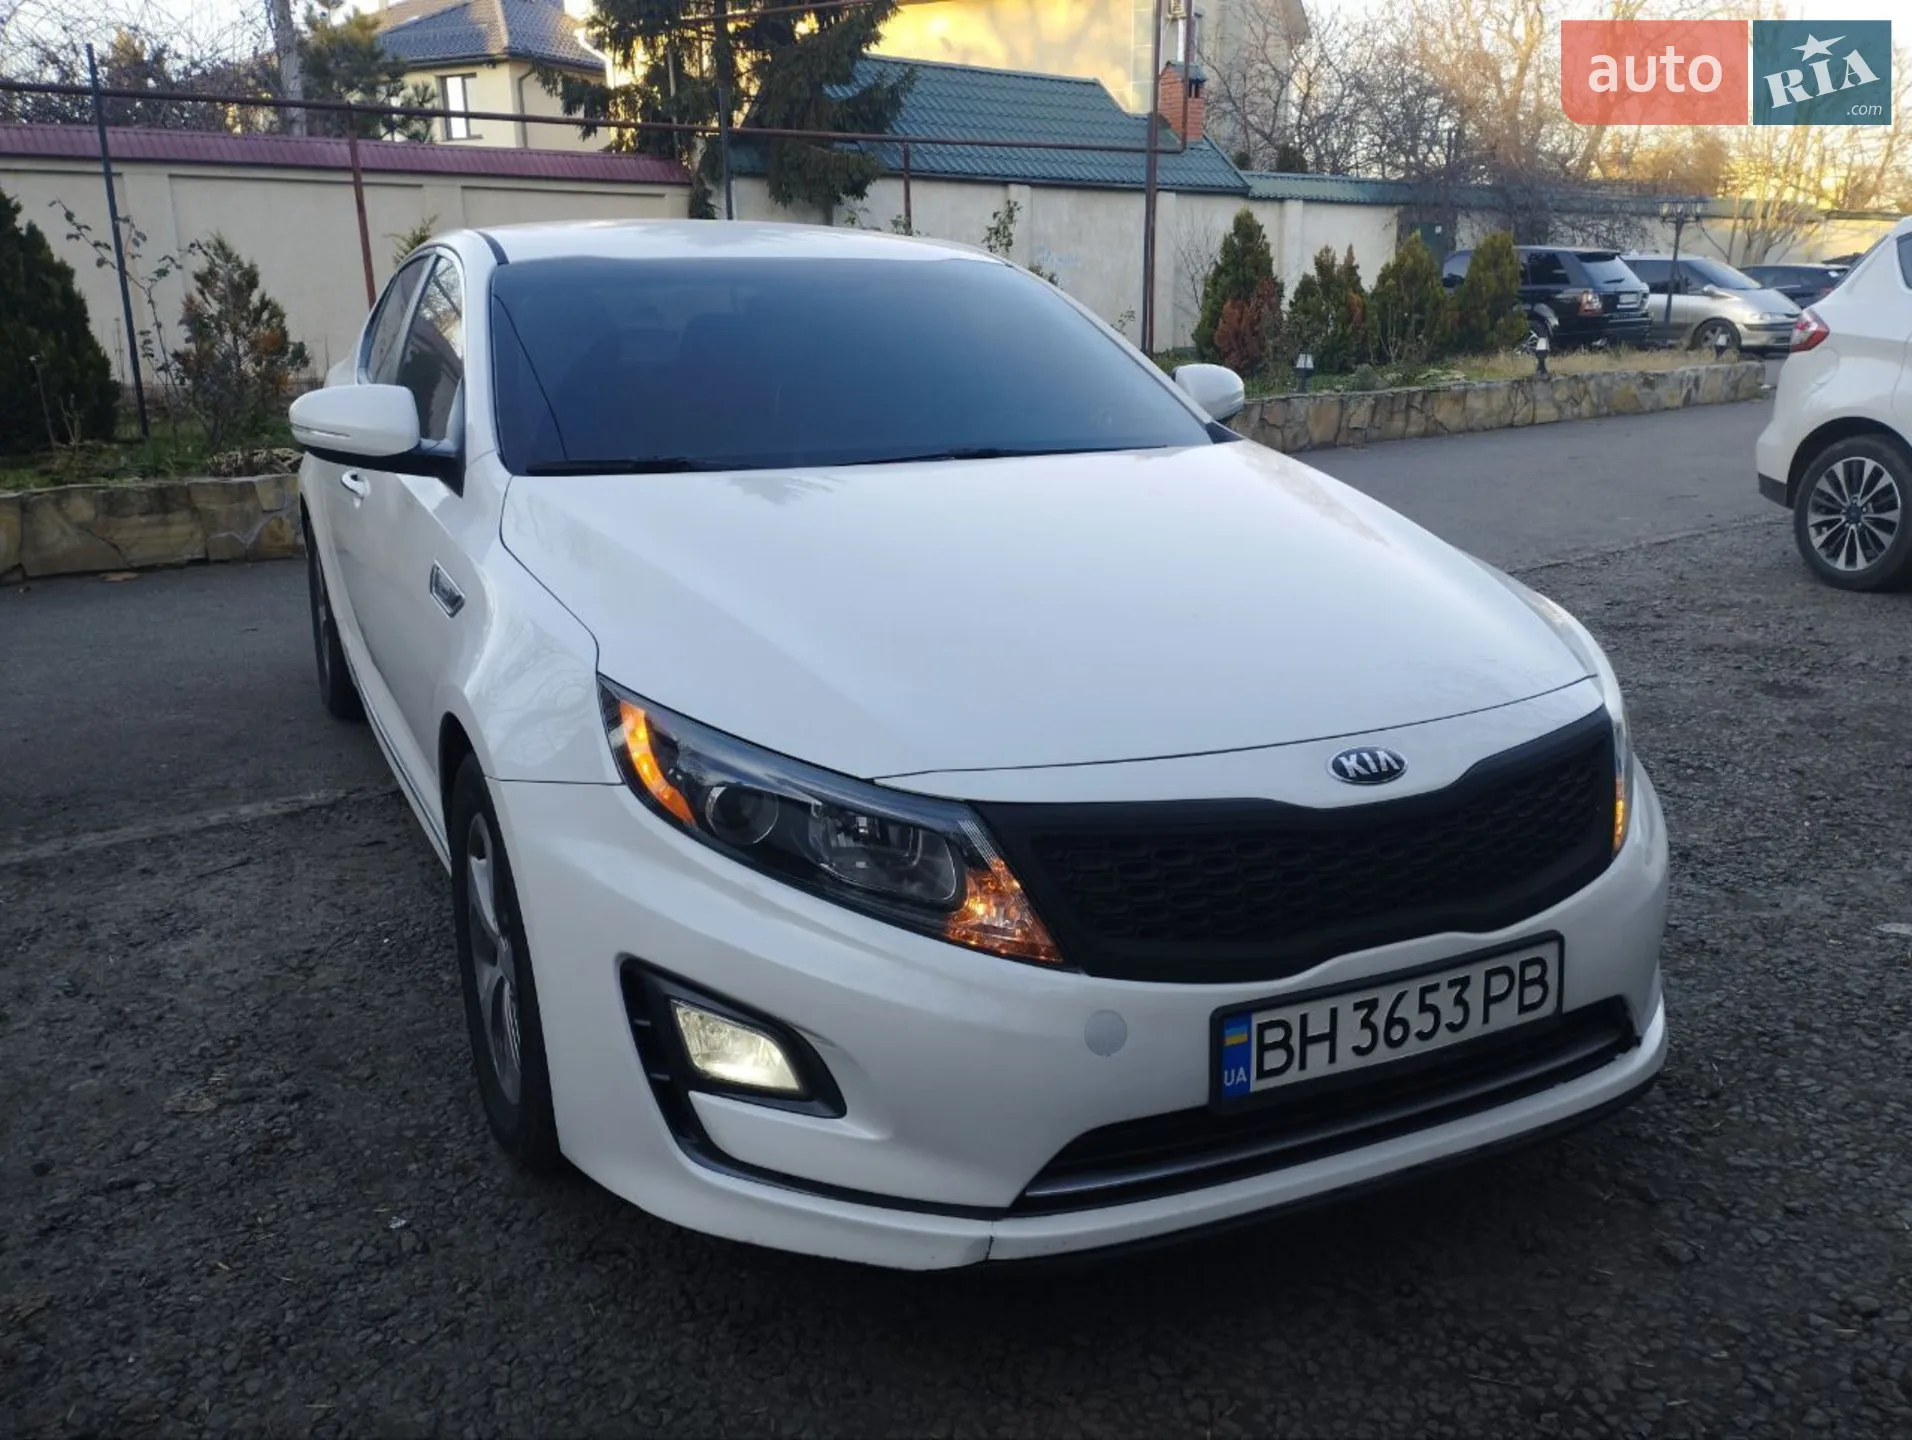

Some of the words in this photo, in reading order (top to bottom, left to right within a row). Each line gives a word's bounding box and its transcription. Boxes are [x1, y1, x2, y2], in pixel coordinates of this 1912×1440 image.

[1338, 750, 1401, 778] KIA
[1255, 1006, 1339, 1081] BH
[1351, 975, 1472, 1057] 3653
[1482, 956, 1549, 1025] PB
[1223, 1066, 1248, 1087] UA
